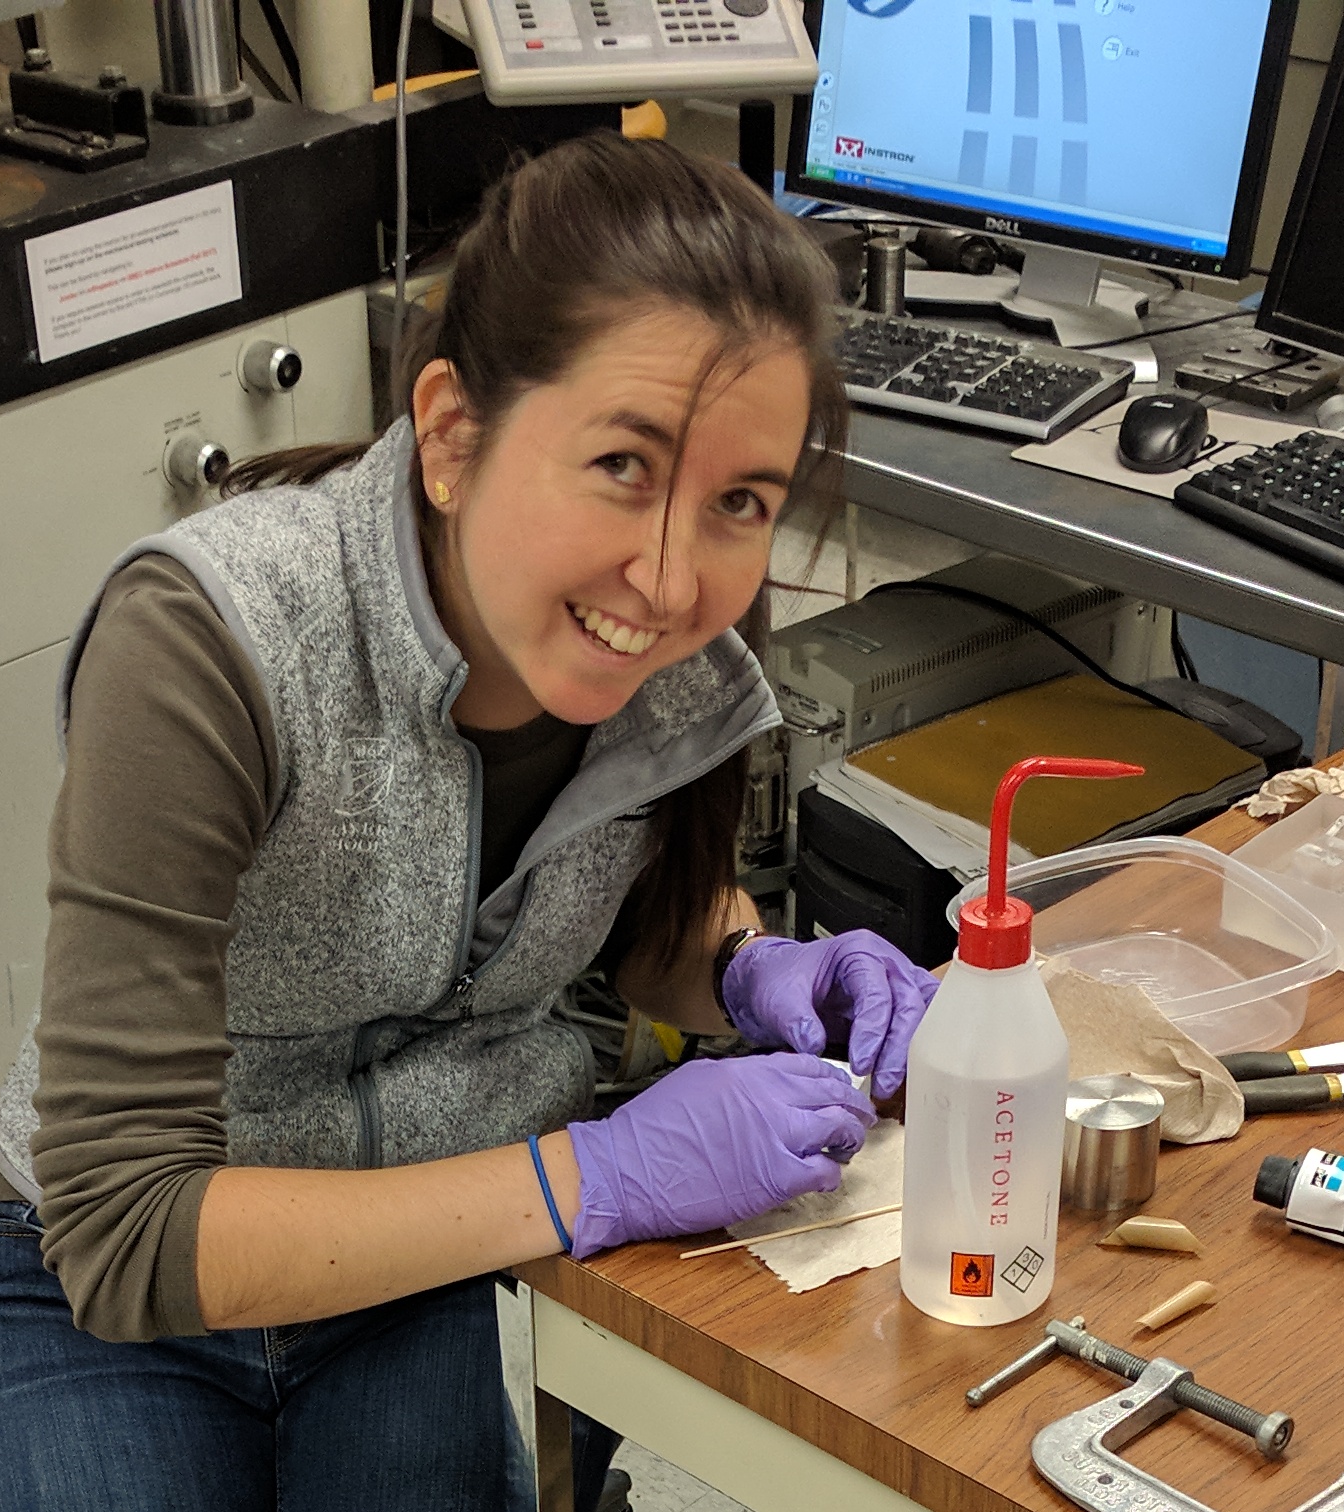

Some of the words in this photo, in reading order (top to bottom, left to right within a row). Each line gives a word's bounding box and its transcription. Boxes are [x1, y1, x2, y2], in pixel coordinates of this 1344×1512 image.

[864, 146, 914, 163] INSTRON
[984, 216, 1021, 236] DELL
[990, 1090, 1015, 1226] ACETONE
[1022, 1253, 1030, 1262] 3
